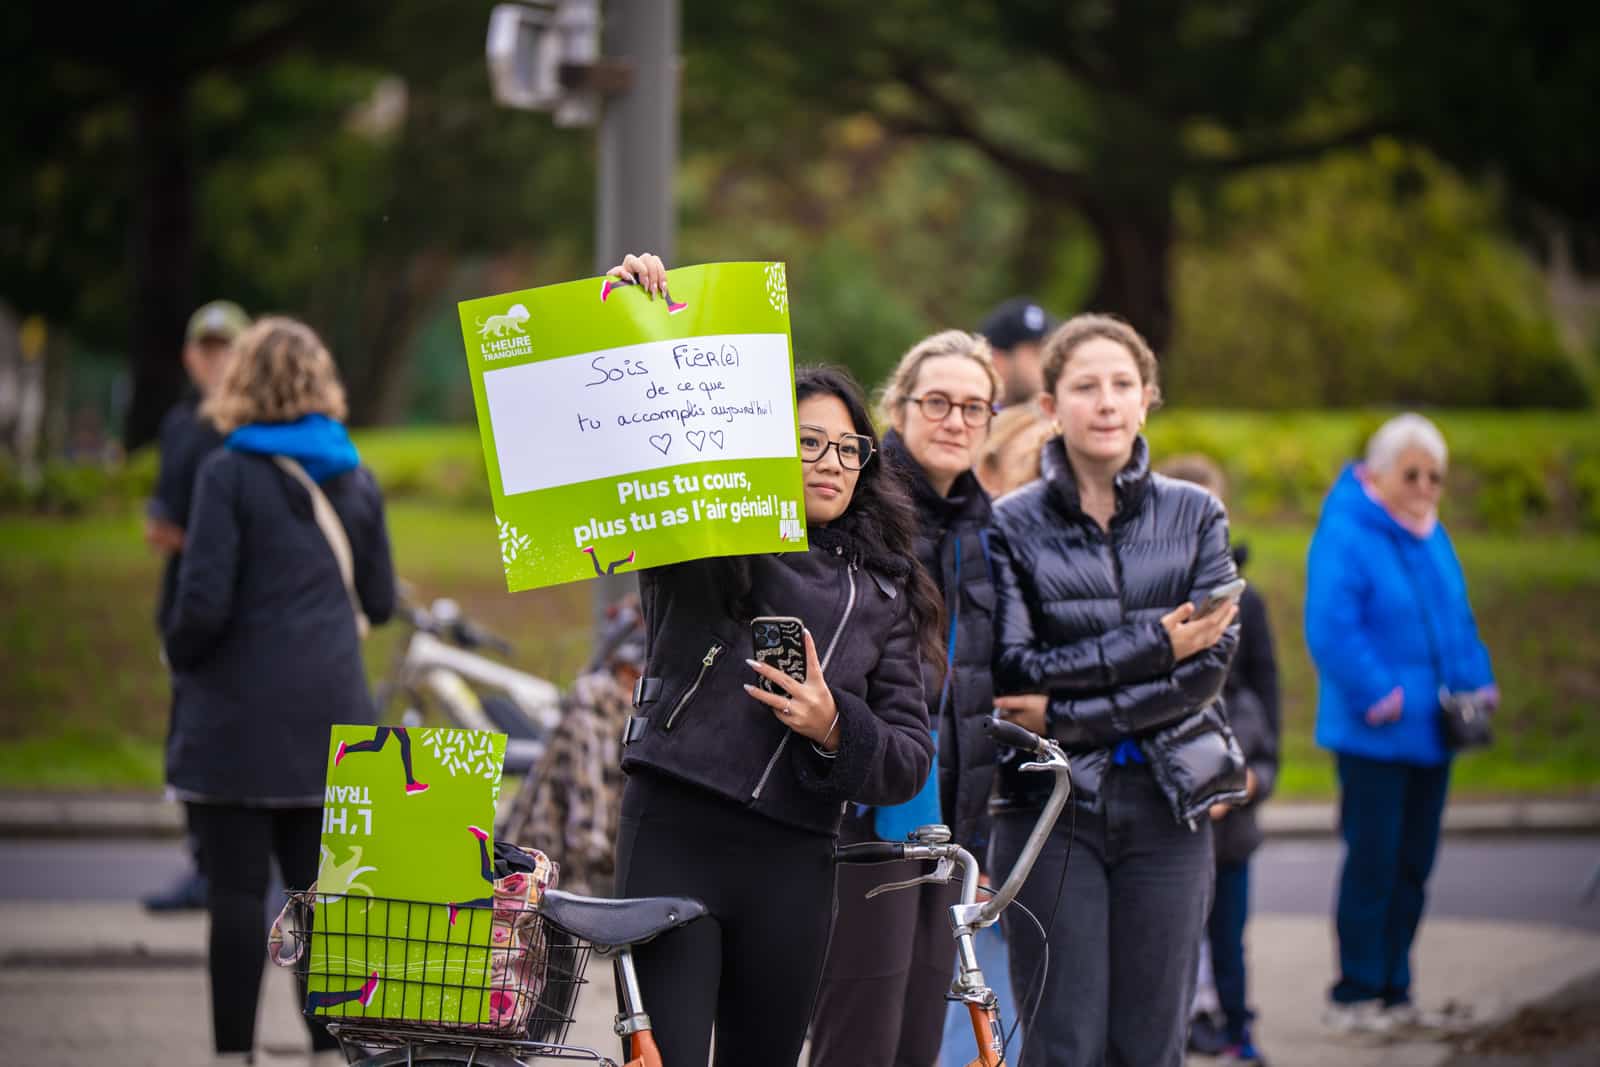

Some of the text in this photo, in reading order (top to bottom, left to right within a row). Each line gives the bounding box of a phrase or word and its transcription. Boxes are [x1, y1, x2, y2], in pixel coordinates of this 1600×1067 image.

[481, 335, 532, 354] L'HEURE
[483, 346, 533, 361] TRANQUILLE
[585, 356, 648, 387] Sois
[646, 380, 726, 400] de ce que
[577, 413, 601, 432] tu
[617, 400, 705, 426] accomplis
[617, 472, 751, 504] Plus tu cours,
[573, 518, 627, 548] plus
[630, 512, 656, 532] tu
[661, 507, 689, 527] as
[692, 498, 727, 521] l'air
